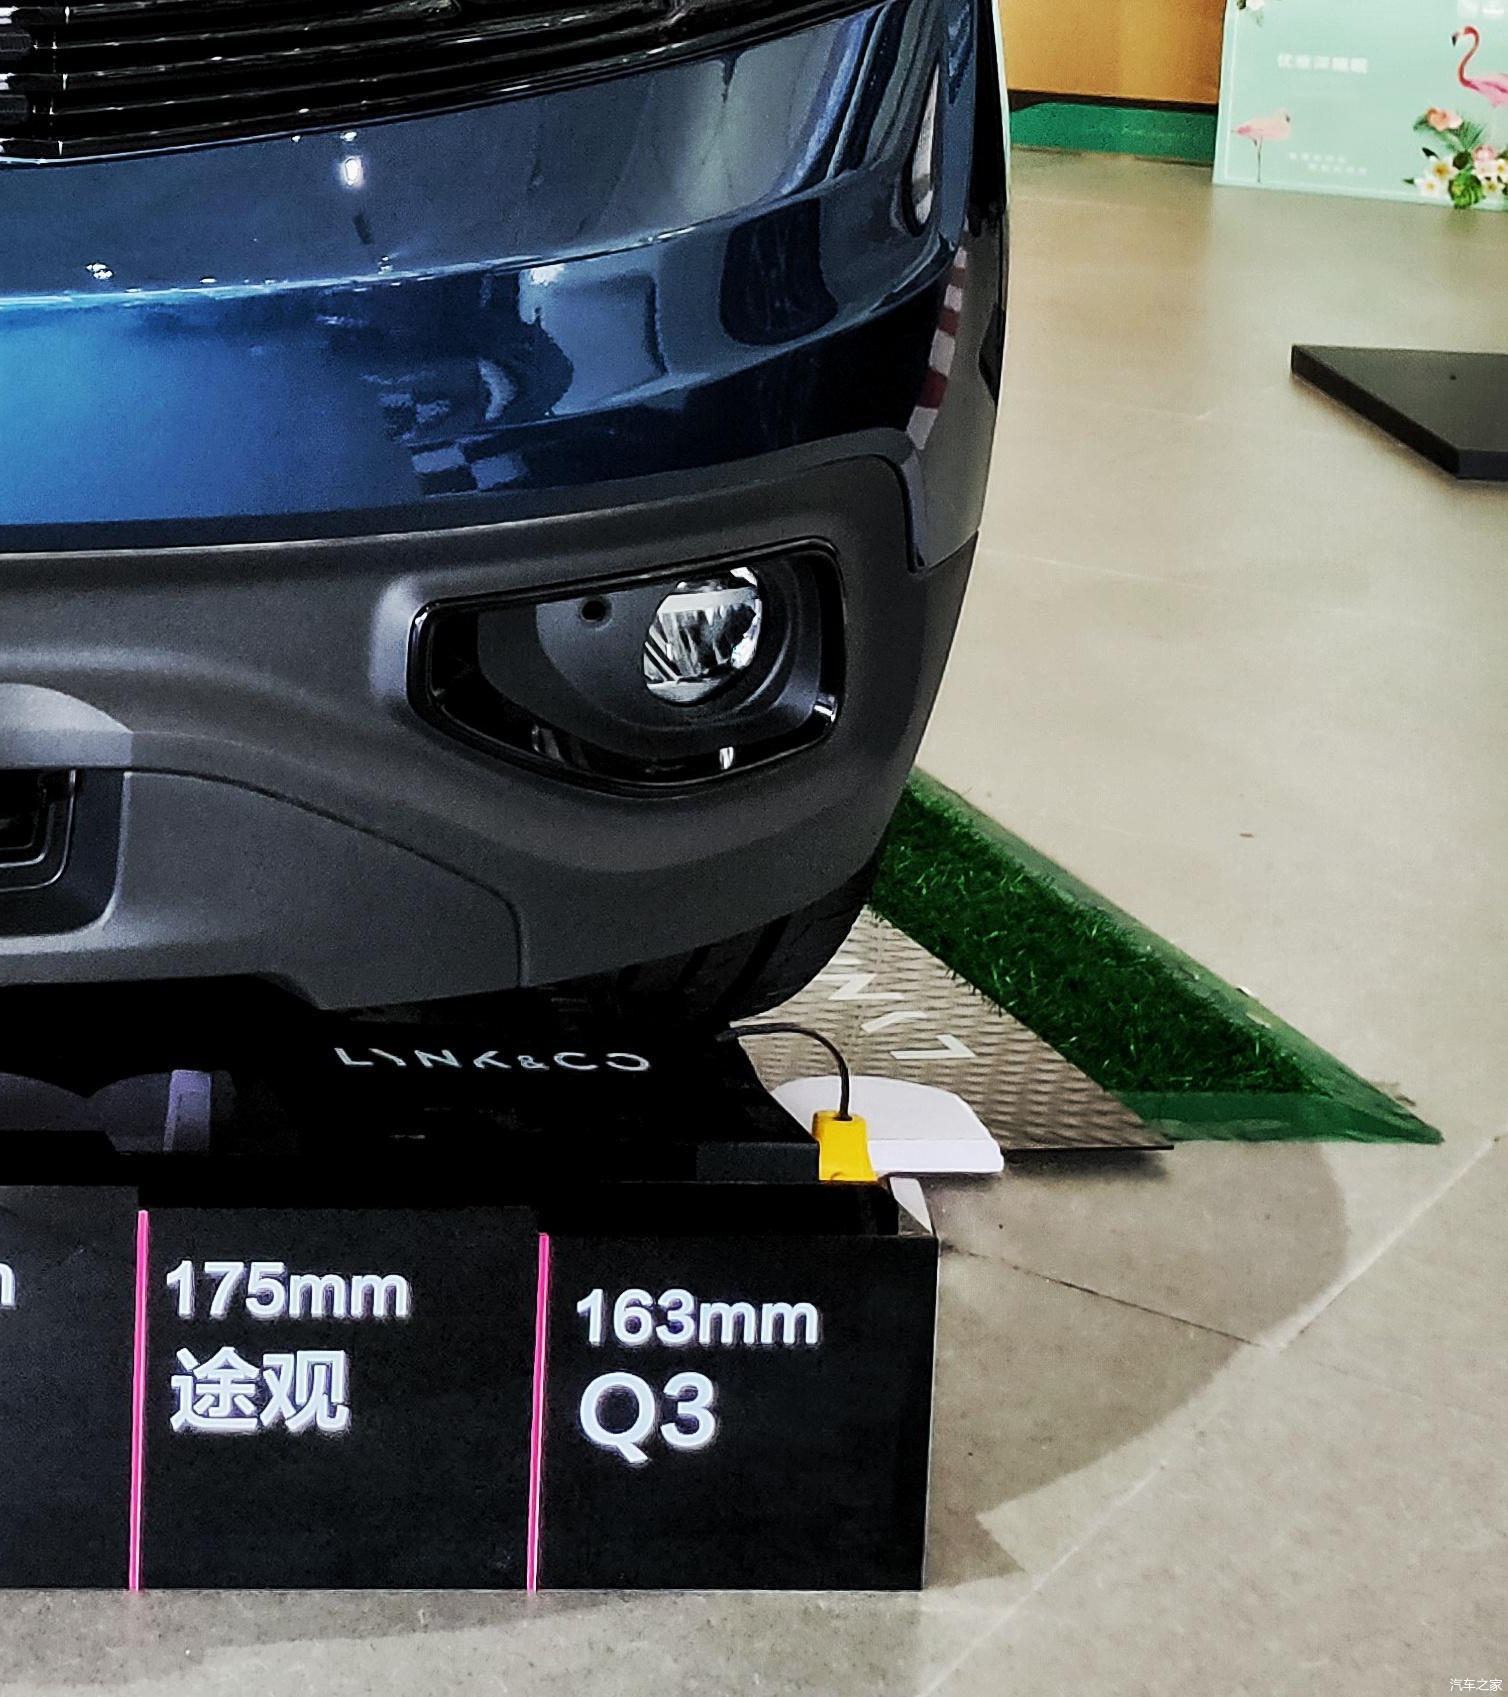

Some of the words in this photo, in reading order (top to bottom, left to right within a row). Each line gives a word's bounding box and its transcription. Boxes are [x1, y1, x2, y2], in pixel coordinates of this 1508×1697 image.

[334, 1046, 652, 1072] LYNK&CO
[165, 1258, 412, 1322] 175mm
[577, 1287, 823, 1348] 163mm
[168, 1347, 353, 1437] 途观
[577, 1368, 720, 1466] Q3
